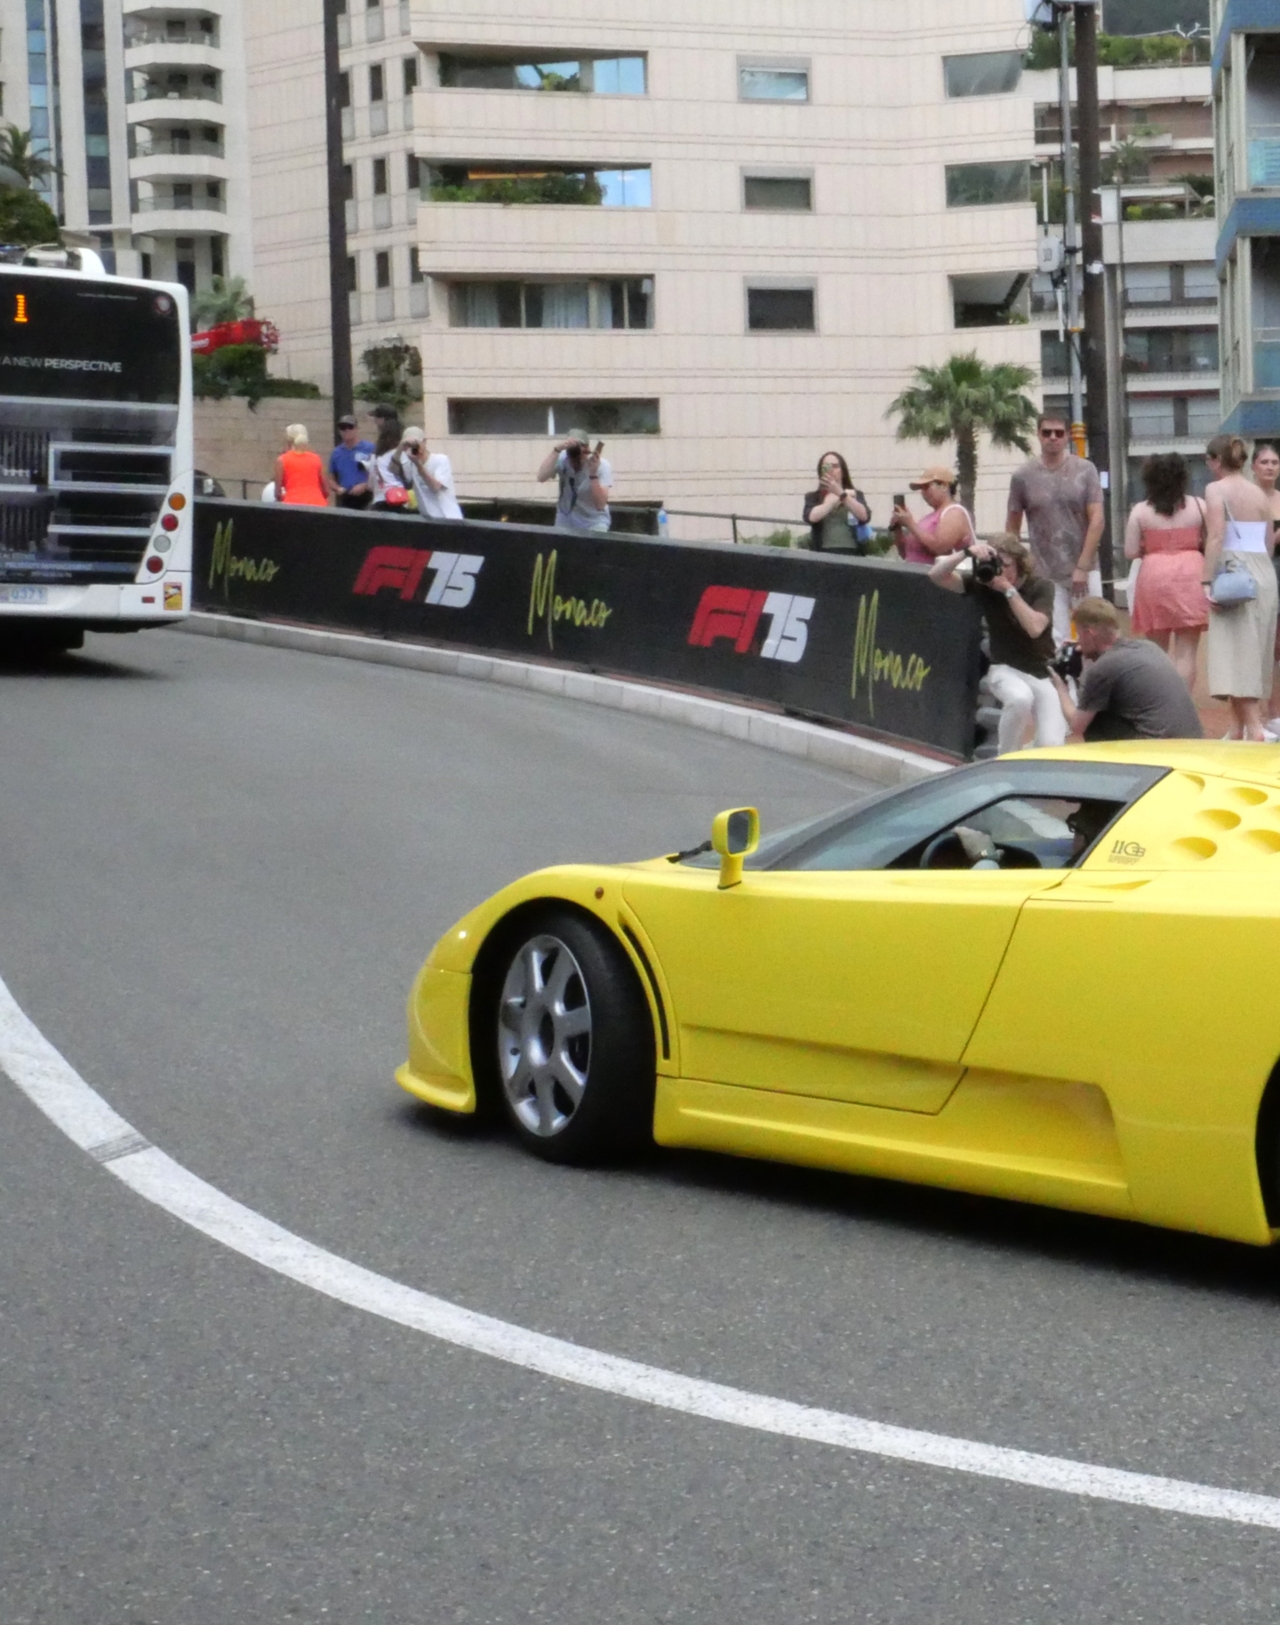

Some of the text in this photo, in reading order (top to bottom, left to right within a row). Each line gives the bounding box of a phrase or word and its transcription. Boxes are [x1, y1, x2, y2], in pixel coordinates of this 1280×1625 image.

[14, 293, 28, 323] 1
[13, 356, 43, 369] NEW
[44, 357, 122, 373] PERSPECTIVE
[209, 518, 280, 599] Monaco
[527, 549, 613, 651] Monaco
[852, 589, 931, 719] Monaco
